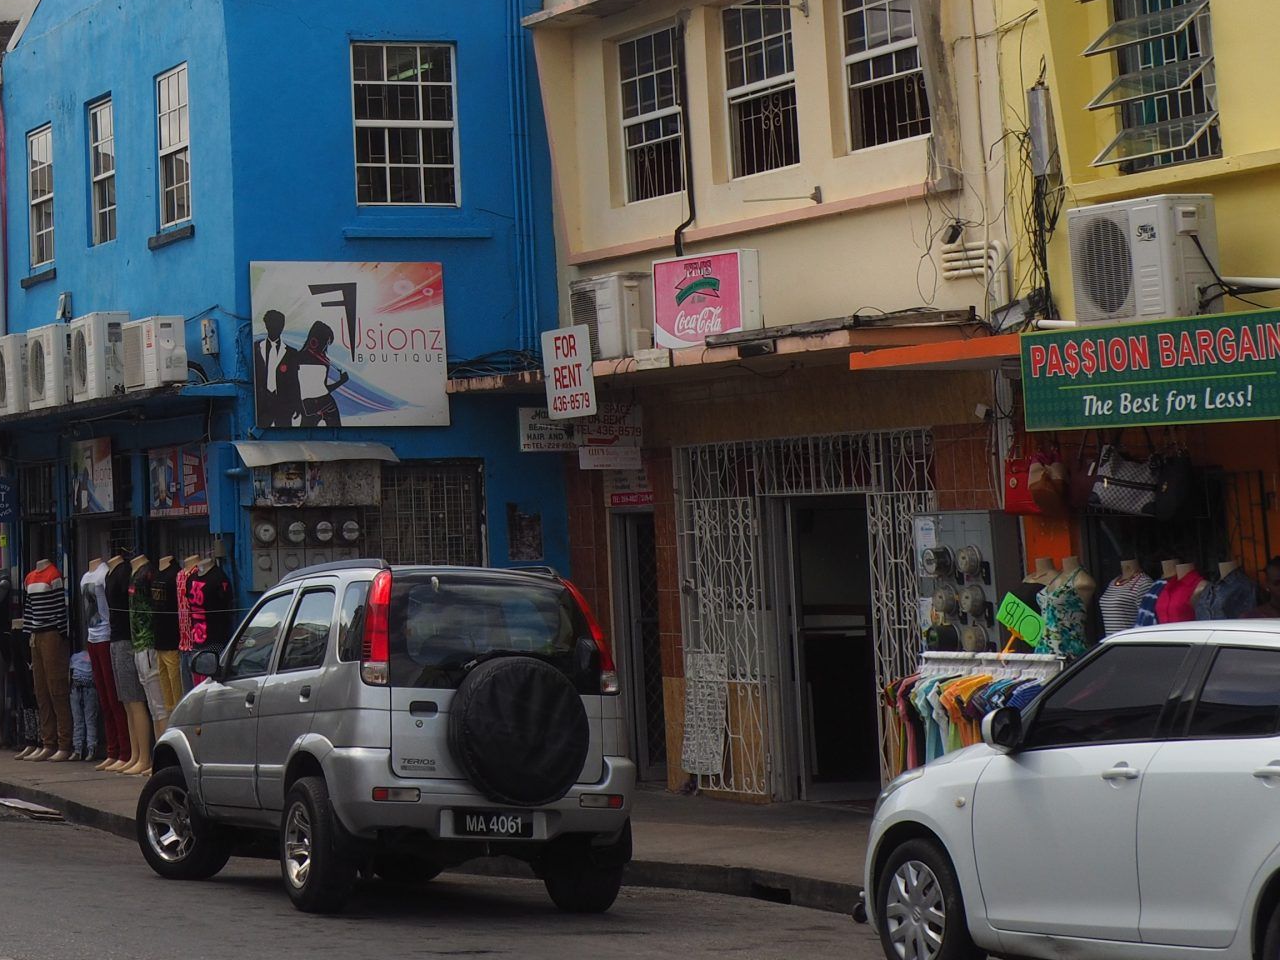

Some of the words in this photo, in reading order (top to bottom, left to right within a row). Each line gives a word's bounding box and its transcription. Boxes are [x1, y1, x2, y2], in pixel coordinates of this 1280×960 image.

[357, 353, 443, 362] BOUTIQUE
[554, 334, 577, 360] FOR
[1029, 335, 1151, 380] PA$$ION
[553, 363, 582, 390] RENT
[552, 392, 590, 413] 436-8579
[1082, 394, 1114, 416] The
[1119, 392, 1160, 414] Best
[1165, 389, 1197, 415] for
[1204, 384, 1253, 410] Less!
[526, 433, 545, 441] HAIR
[1004, 599, 1043, 642] $10
[400, 758, 436, 766] TERIOS
[465, 814, 487, 832] MA
[489, 815, 522, 834] 4061
